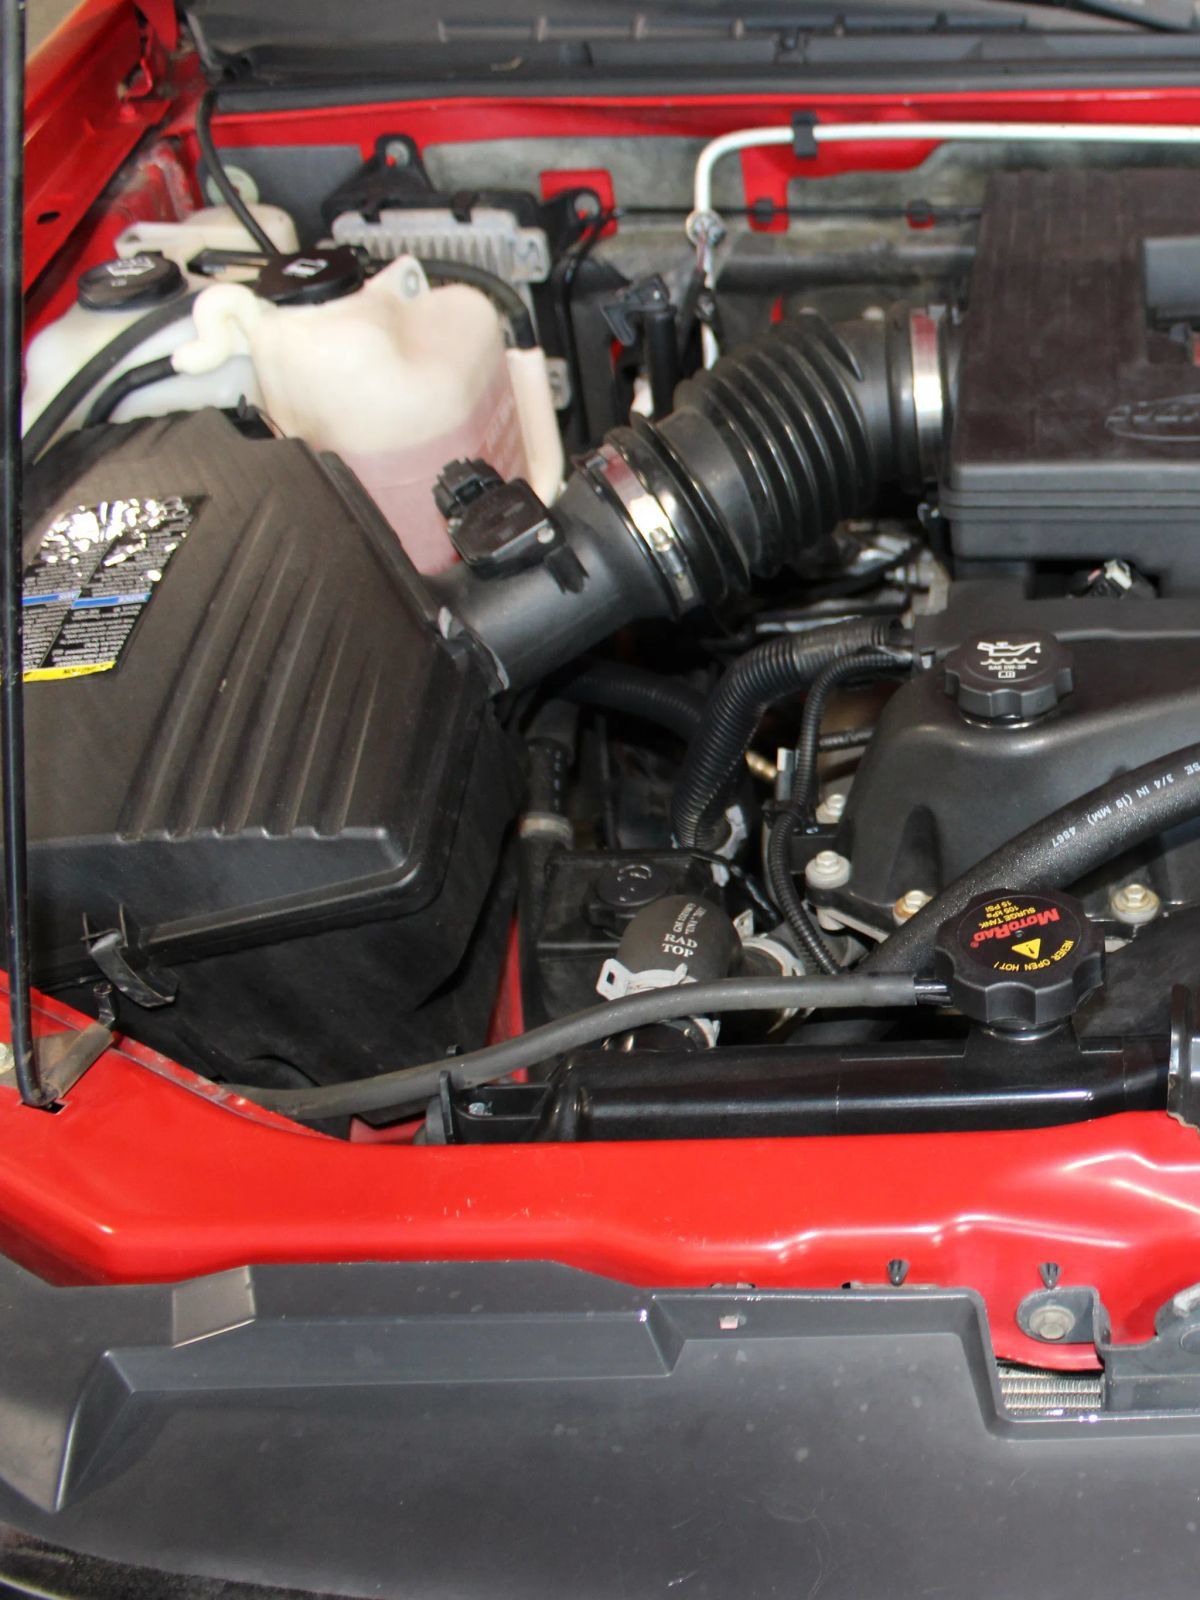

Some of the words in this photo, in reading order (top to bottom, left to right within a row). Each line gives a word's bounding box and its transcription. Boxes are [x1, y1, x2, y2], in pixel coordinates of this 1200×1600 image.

[1153, 773, 1174, 789] 3/4
[1135, 784, 1150, 798] IN
[1053, 826, 1077, 848] 4867
[985, 903, 1001, 912] PSI
[1005, 907, 1036, 922] SURGE
[978, 916, 1005, 929] TANK
[664, 933, 697, 948] RAD
[662, 943, 694, 958] TOP
[1051, 940, 1074, 961] NEVER
[1024, 960, 1051, 972] OPEN
